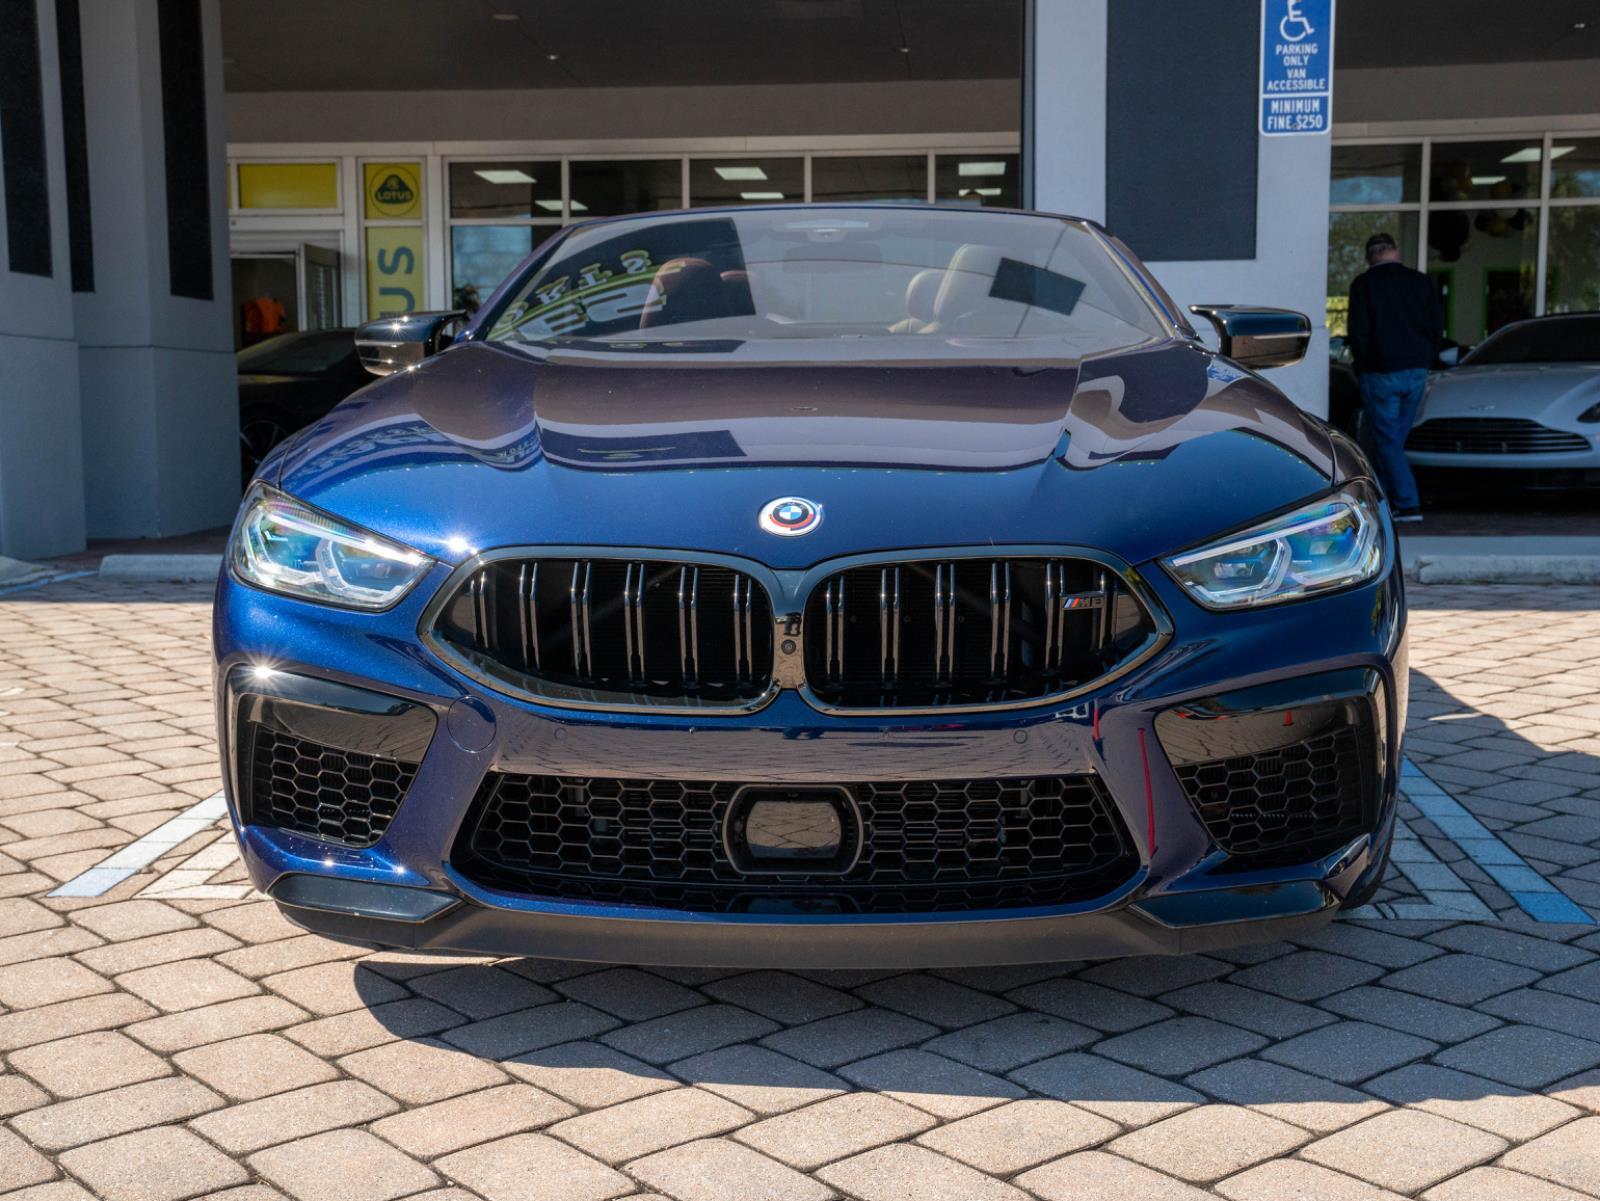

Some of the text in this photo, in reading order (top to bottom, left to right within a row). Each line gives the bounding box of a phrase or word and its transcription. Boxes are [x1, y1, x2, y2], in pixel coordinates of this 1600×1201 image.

[1275, 43, 1318, 55] PARKING
[1283, 55, 1309, 66] ONLY
[1286, 68, 1306, 79] VAN
[1266, 79, 1326, 91] ACCESSIBLE
[1271, 99, 1320, 114] MINIMUM
[1267, 114, 1323, 130] FINE $250
[377, 191, 412, 201] LOTUS
